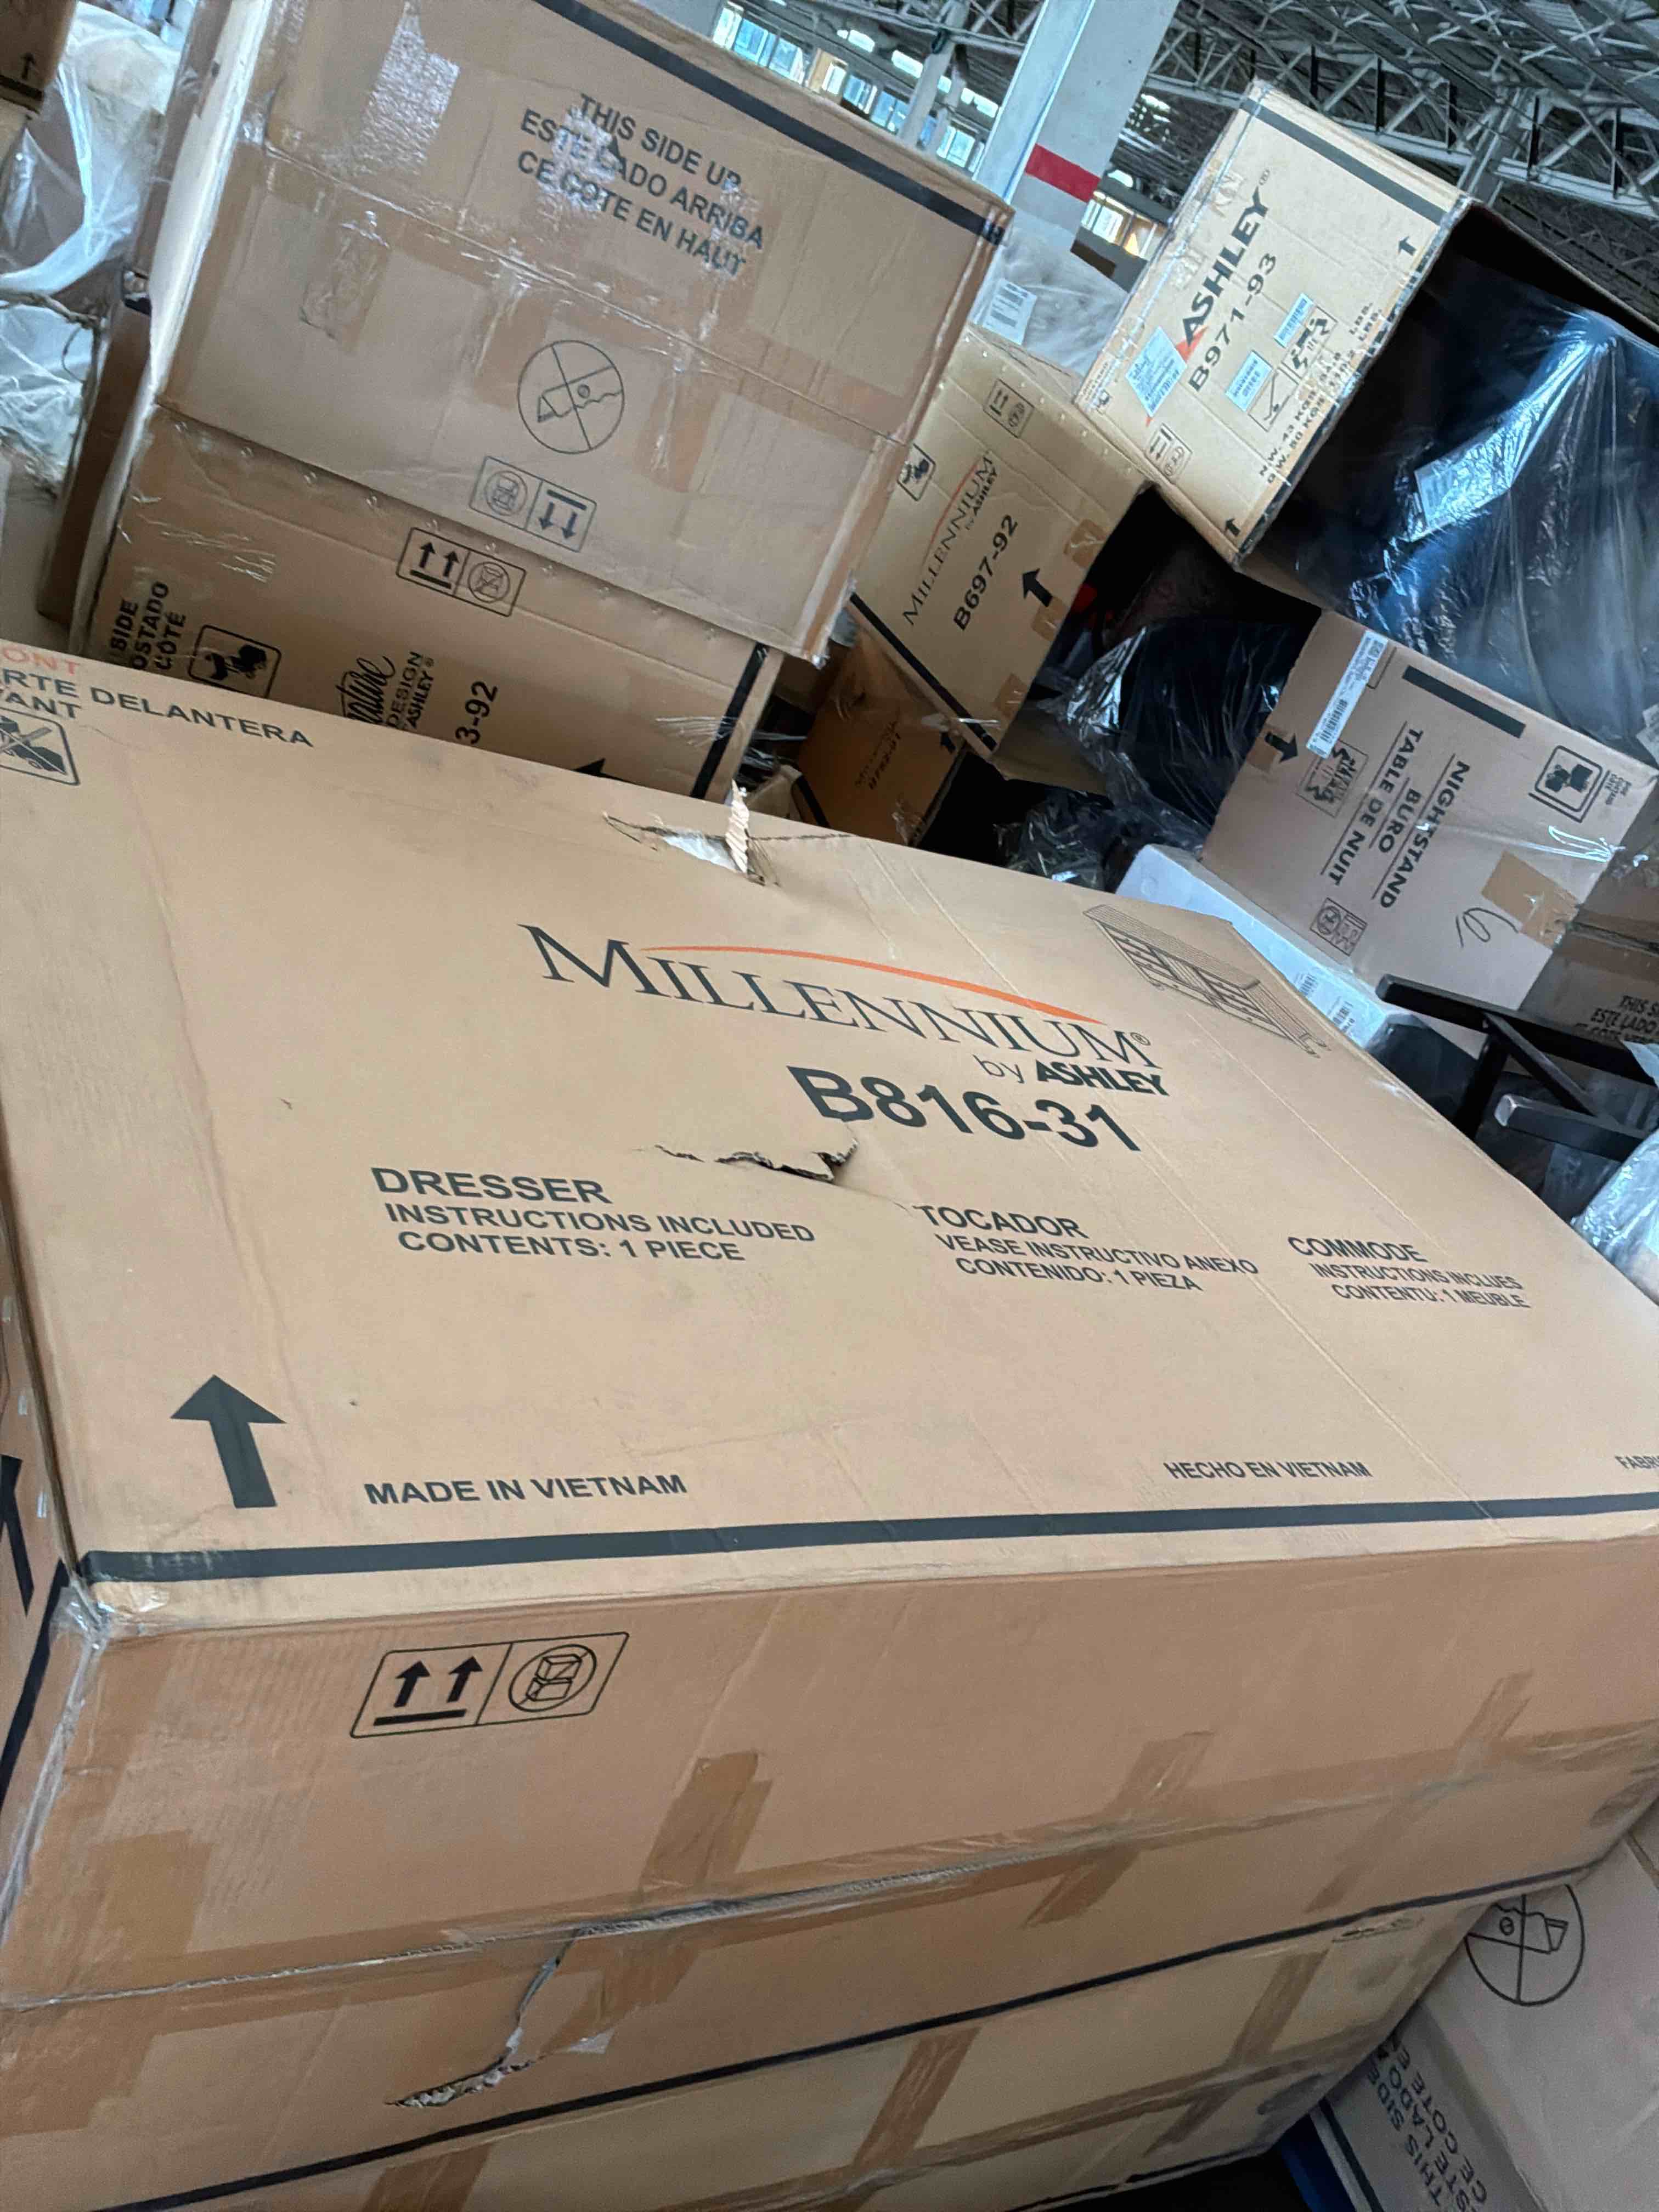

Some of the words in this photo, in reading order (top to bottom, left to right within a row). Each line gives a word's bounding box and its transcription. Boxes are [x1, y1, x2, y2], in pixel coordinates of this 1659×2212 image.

[580, 93, 636, 140] THIS
[641, 127, 702, 175] SIDE
[706, 160, 742, 192] UP
[518, 150, 555, 185] CE
[636, 208, 673, 241] EN
[676, 228, 746, 275] HAUT
[669, 187, 763, 249] ARRIBA
[1183, 186, 1268, 346] ASHLEY
[1189, 253, 1277, 392] B971-93
[902, 454, 993, 627] MILLENNIUM
[952, 514, 1019, 631] B697-92
[132, 582, 168, 669] OSTADO
[3, 646, 81, 675] ONT
[386, 651, 424, 728] DESIGN
[3, 692, 81, 719] ANT
[3, 668, 76, 697] RTE
[90, 687, 313, 747] DELANTERA
[455, 681, 498, 744] 3-92
[1378, 728, 1424, 792] TABLE
[1359, 797, 1385, 828] DE
[1378, 788, 1421, 854] BURO
[1379, 761, 1470, 910] NIGHTSTAND
[1333, 829, 1366, 885] NUIT
[517, 924, 1163, 1069] MILLENNIUM
[973, 1054, 1024, 1083] by
[1036, 1060, 1170, 1096] ASHLEY
[786, 1065, 1141, 1151] B816-31
[370, 1167, 613, 1204] DRESSER
[385, 1203, 651, 1232] INSTRUCTIONS
[657, 1215, 815, 1242] INCLUDED
[398, 1232, 612, 1257] CONTENTS:
[619, 1241, 639, 1258] 1
[650, 1241, 746, 1261] PIECE
[912, 1205, 1090, 1239] TOCADOR
[1287, 1236, 1428, 1262] COMMODE
[934, 1233, 1026, 1257] VEASE
[1025, 1242, 1180, 1268] INSTRUCTIVO
[1185, 1255, 1260, 1275] ANEXO
[956, 1259, 1111, 1284] CONTENIDO:
[1113, 1270, 1130, 1285] 1
[1135, 1274, 1203, 1291] PIEZA
[1311, 1262, 1451, 1285] INSTRUCTIONS
[1450, 1272, 1523, 1290] INCLUES
[1444, 1290, 1457, 1303] 1
[1459, 1290, 1531, 1308] MEUBLE
[364, 1480, 481, 1505] MADE
[487, 1479, 526, 1500] IN
[531, 1474, 688, 1499] VIETNAM
[1164, 1461, 1245, 1480] HECHO
[1249, 1462, 1279, 1477] EN
[1280, 1461, 1373, 1478] VIETNAM
[1615, 1455, 1659, 1470] FABRI
[1434, 2150, 1476, 2212] STE
